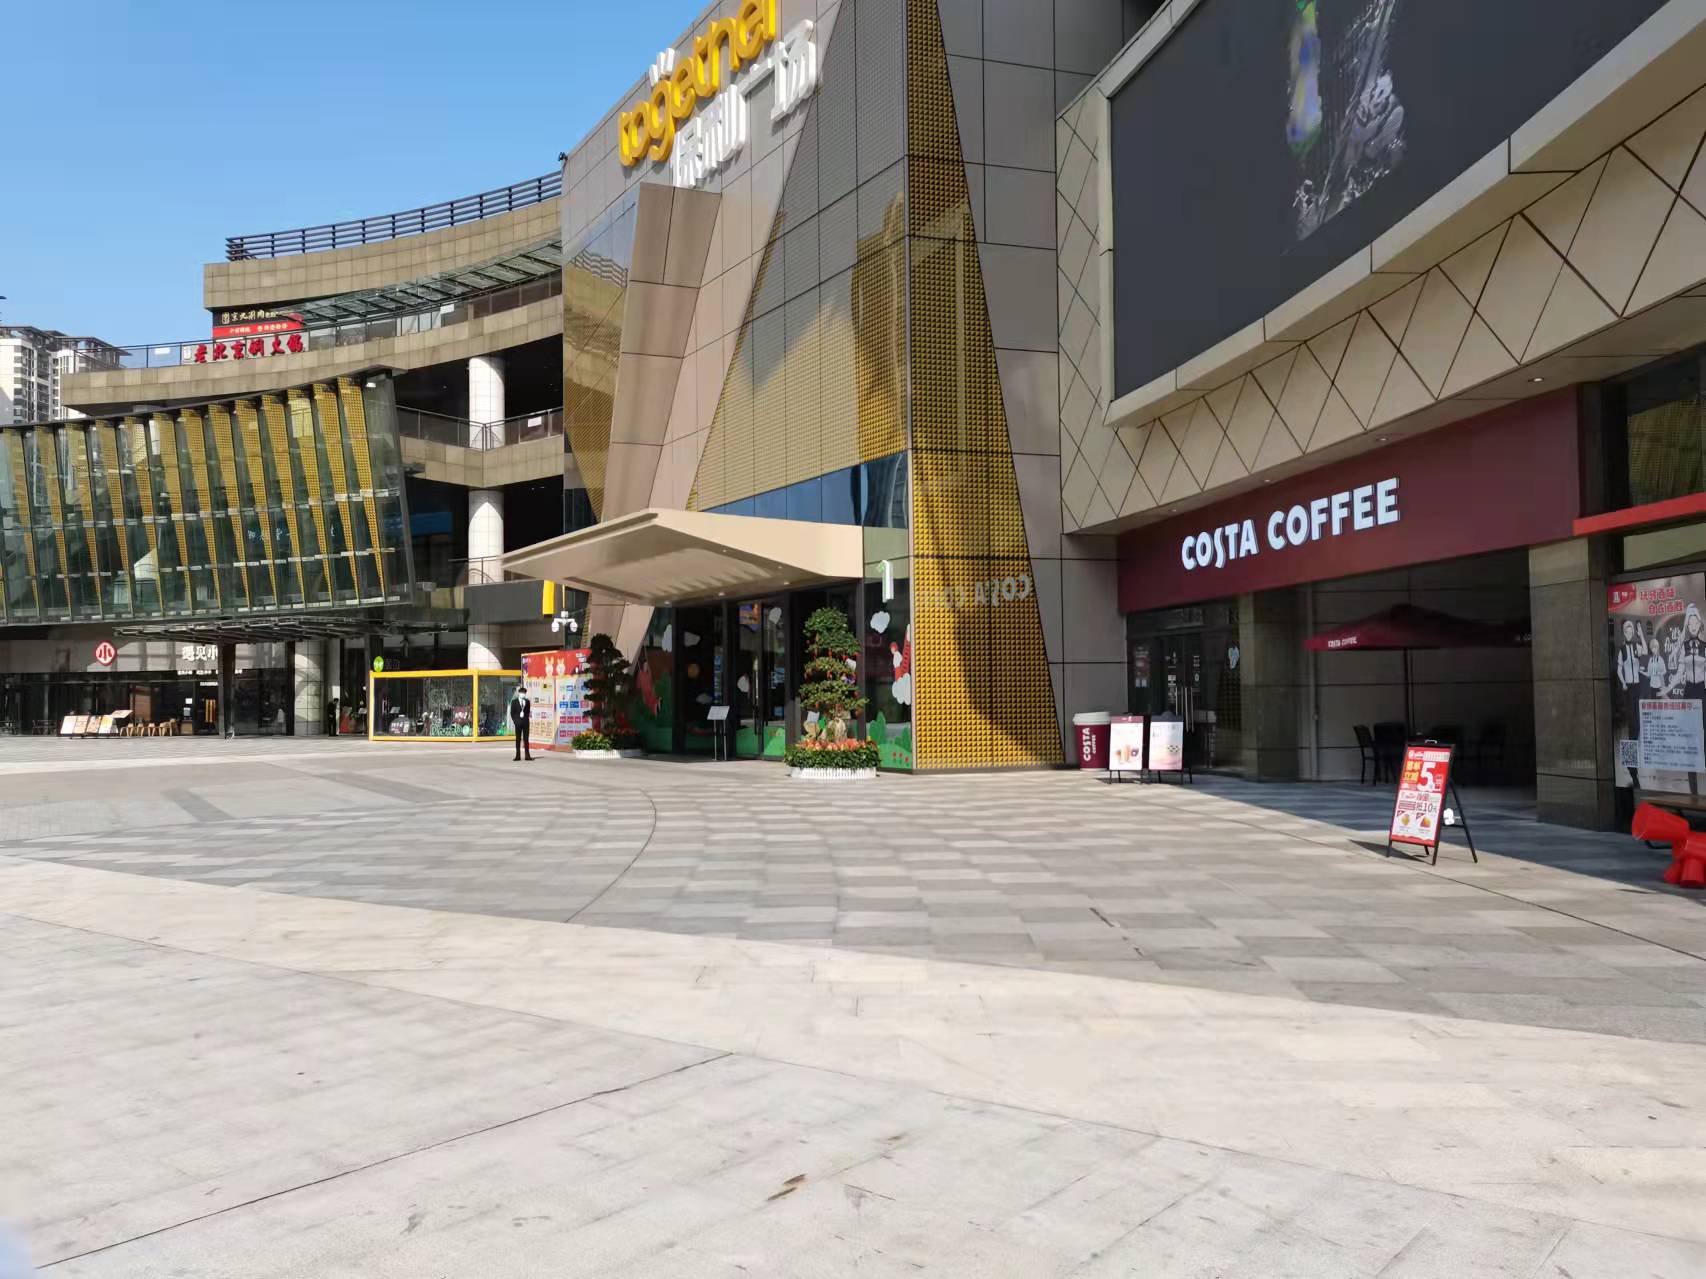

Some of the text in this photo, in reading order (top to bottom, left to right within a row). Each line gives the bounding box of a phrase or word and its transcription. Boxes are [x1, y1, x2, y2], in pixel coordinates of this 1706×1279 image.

[1181, 477, 1401, 571] COSTA COFFEE
[1082, 727, 1092, 761] COSTA
[1417, 762, 1437, 792] 5
